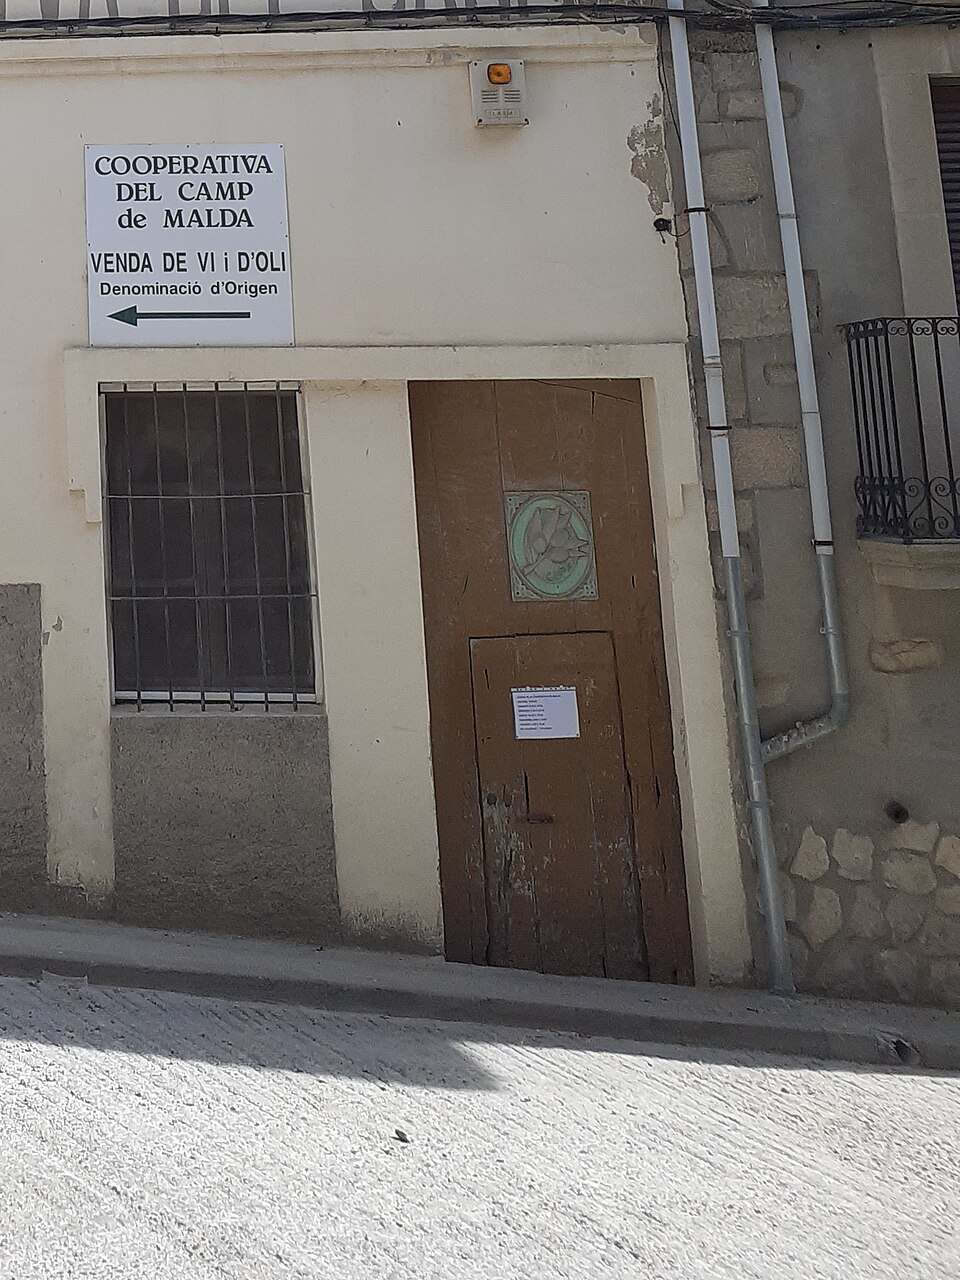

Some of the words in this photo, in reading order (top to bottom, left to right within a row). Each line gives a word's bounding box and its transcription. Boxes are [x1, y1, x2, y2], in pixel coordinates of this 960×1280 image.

[94, 154, 273, 176] COOPERATIVA
[116, 182, 163, 202] DEL
[178, 181, 254, 201] CAMP
[117, 208, 147, 229] de
[163, 208, 254, 228] MALDA
[90, 252, 153, 273] VENDA
[163, 252, 188, 272] DE
[197, 251, 215, 272] VI
[224, 251, 229, 272] i
[238, 251, 286, 272] D'OLI
[100, 281, 202, 296] Denominació
[210, 281, 278, 298] d'Origen
